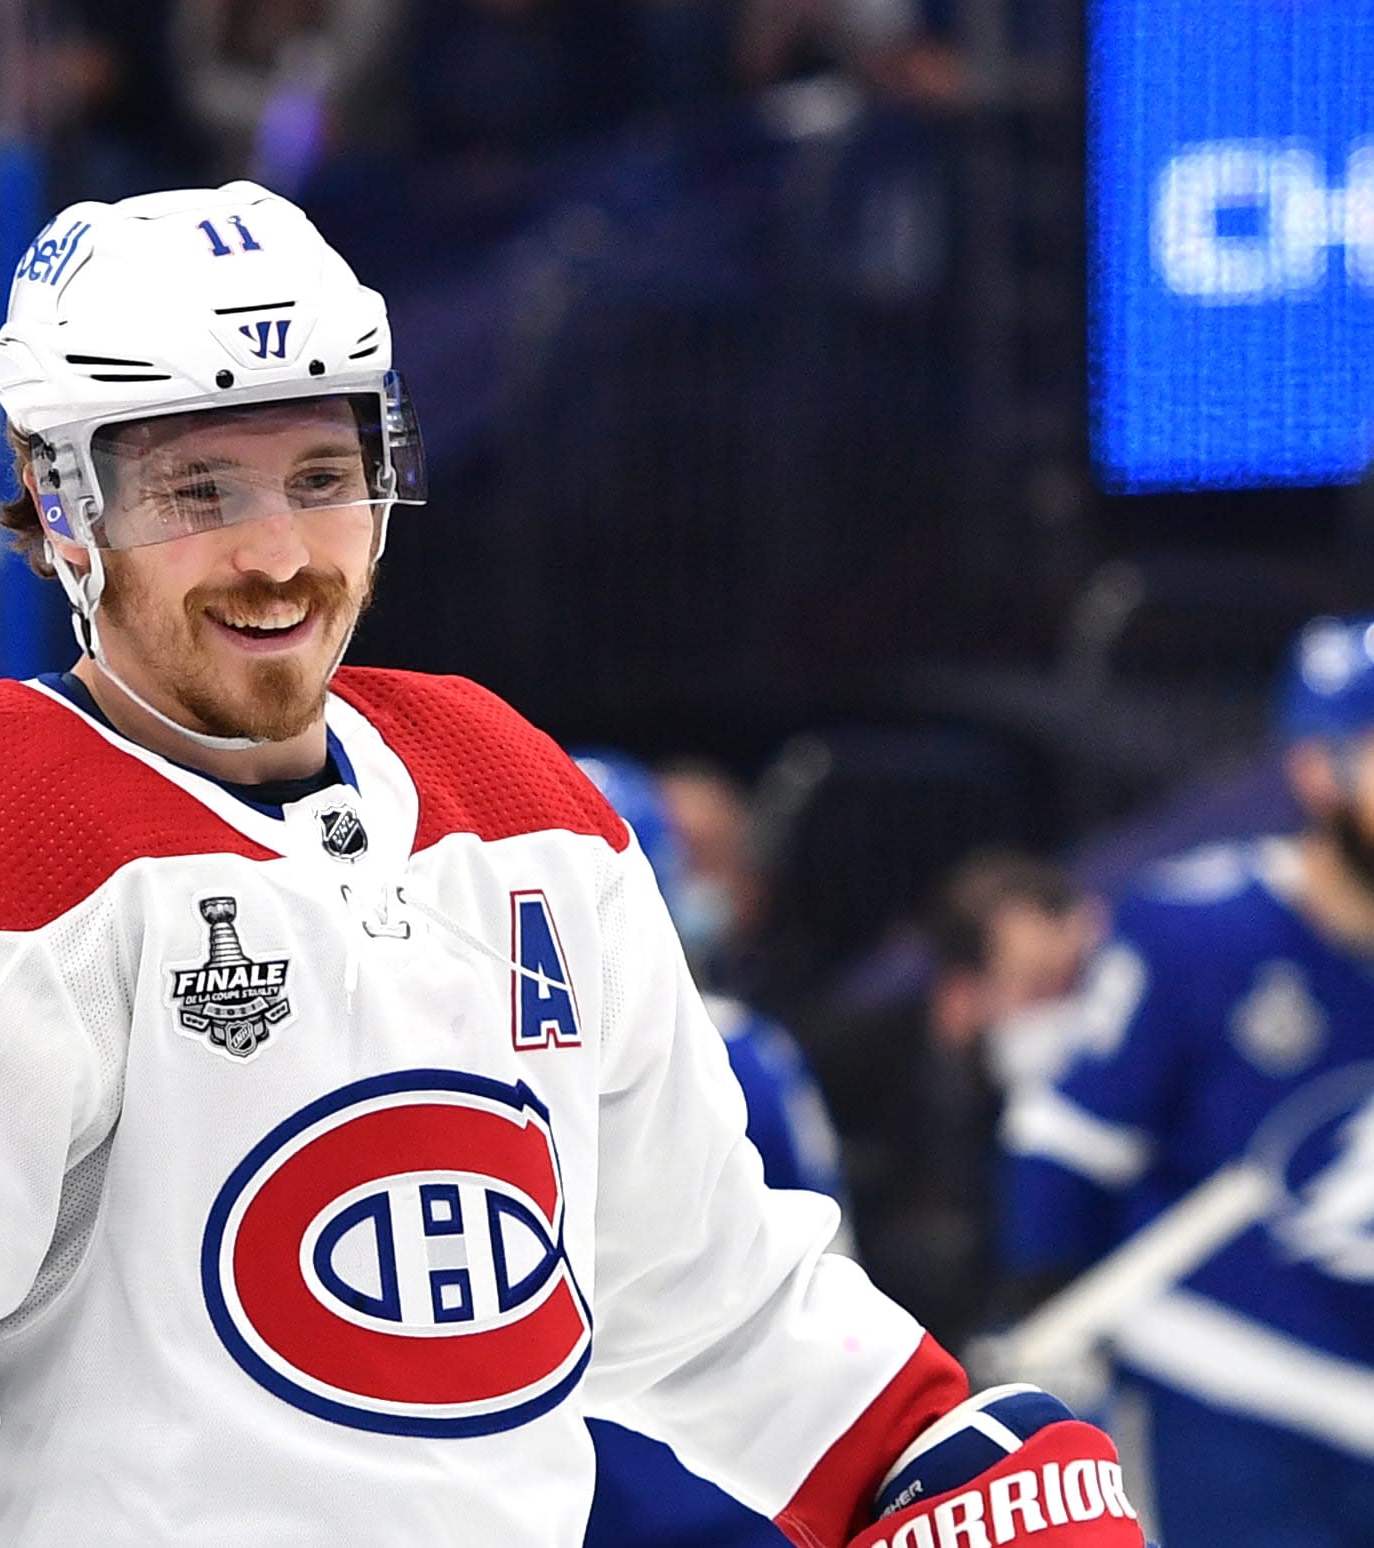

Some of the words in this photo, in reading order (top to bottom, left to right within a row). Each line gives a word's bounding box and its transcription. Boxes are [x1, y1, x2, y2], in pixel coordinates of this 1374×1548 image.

[193, 214, 265, 258] 11
[177, 963, 285, 996] FINALE
[509, 888, 582, 1052] A
[185, 995, 198, 1006] DE
[198, 994, 211, 1003] LA
[211, 990, 241, 1001] COUPE
[868, 1459, 1138, 1548] ARRIOR
